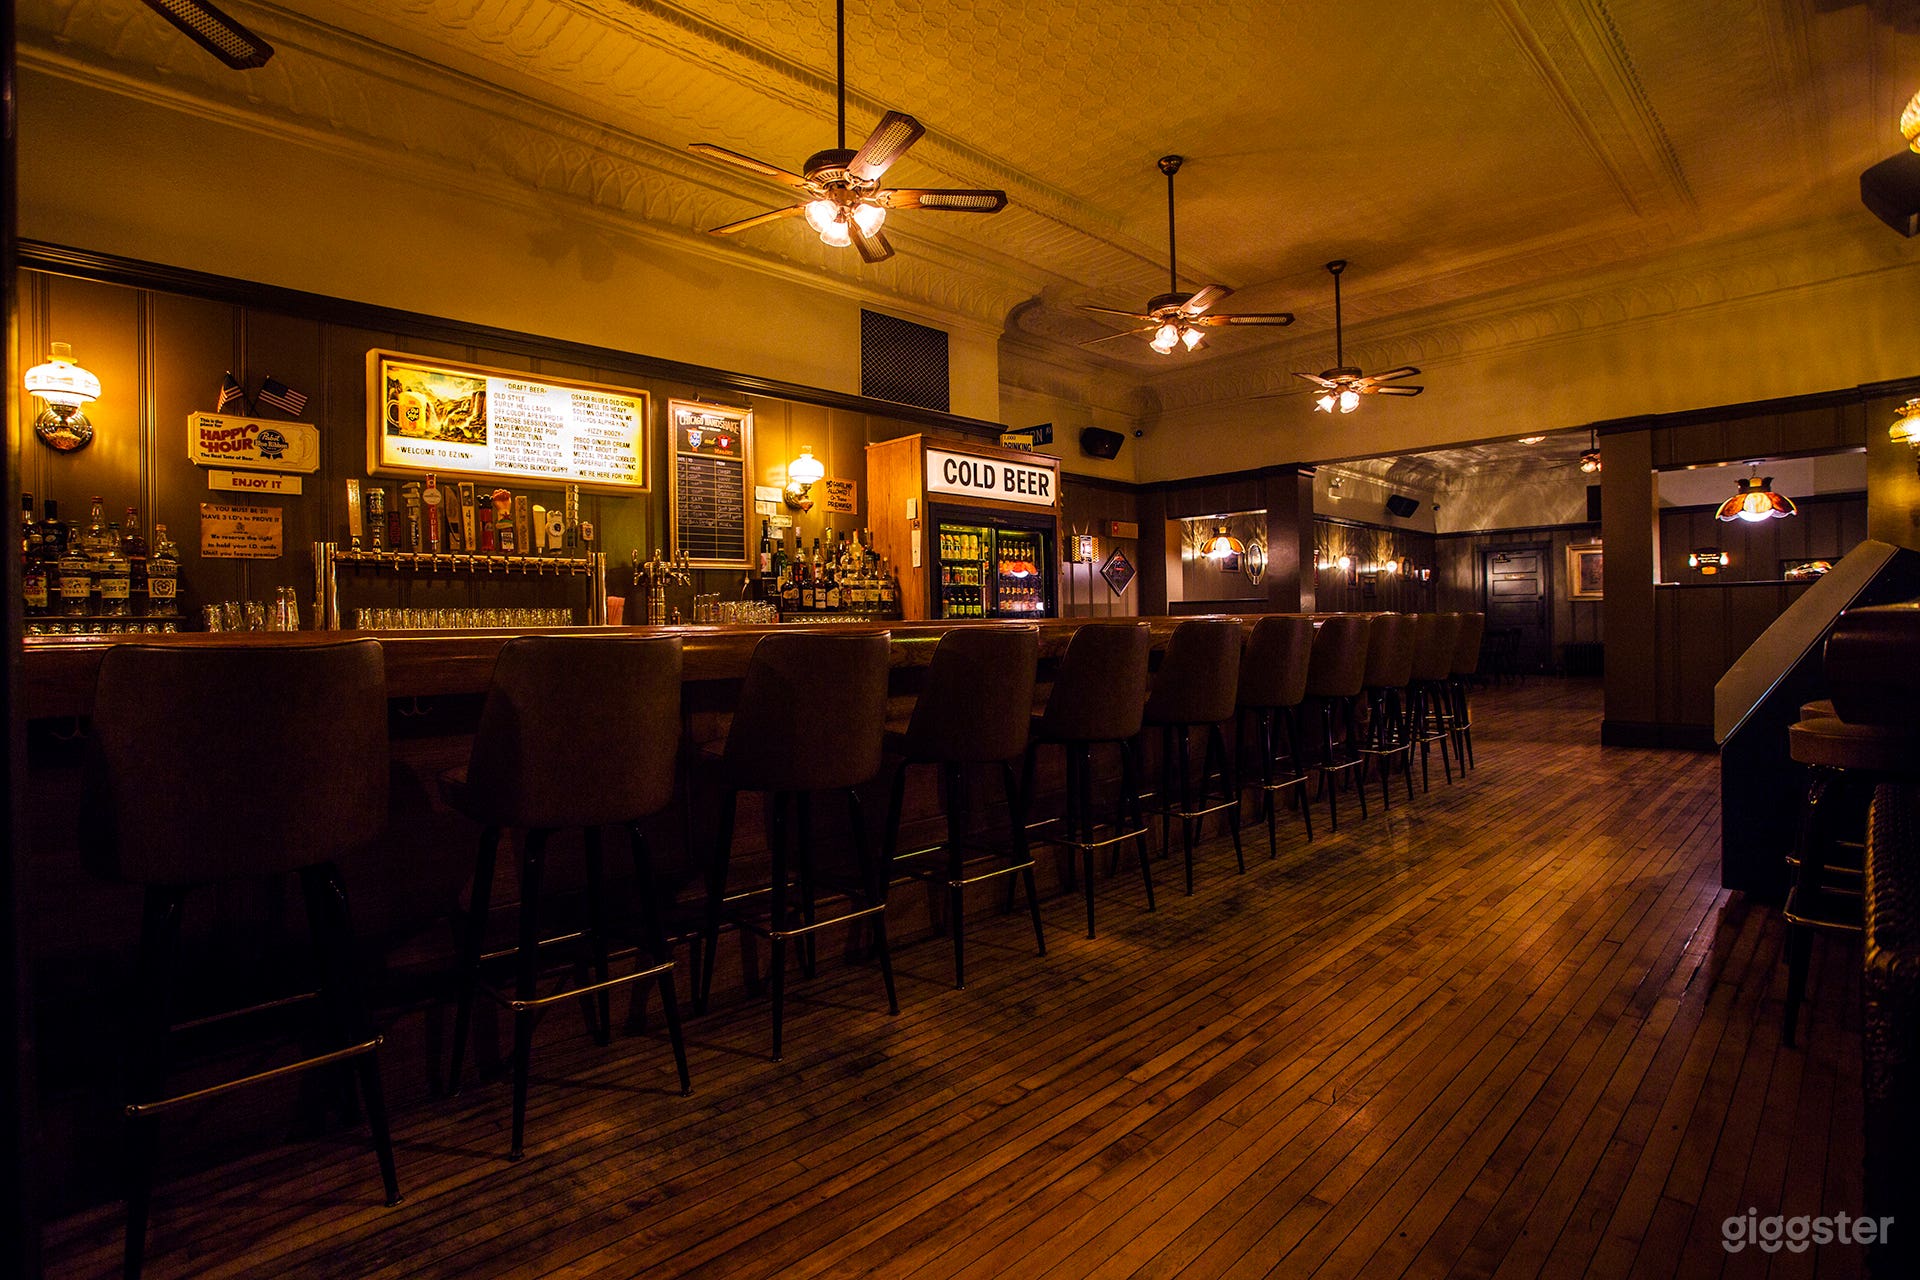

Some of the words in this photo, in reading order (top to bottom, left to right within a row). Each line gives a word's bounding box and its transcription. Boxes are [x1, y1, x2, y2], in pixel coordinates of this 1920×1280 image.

[508, 383, 528, 391] DRAFT
[494, 392, 506, 400] OLD
[508, 394, 525, 403] STYLE
[591, 396, 608, 404] BLUES
[200, 424, 259, 440] HAPPY
[200, 438, 254, 453] HOUR
[400, 446, 435, 456] WELCOME
[438, 449, 447, 457] TO
[944, 458, 996, 489] COLD
[1004, 467, 1050, 497] BEER
[232, 478, 269, 488] ENJOY
[272, 481, 282, 489] IT
